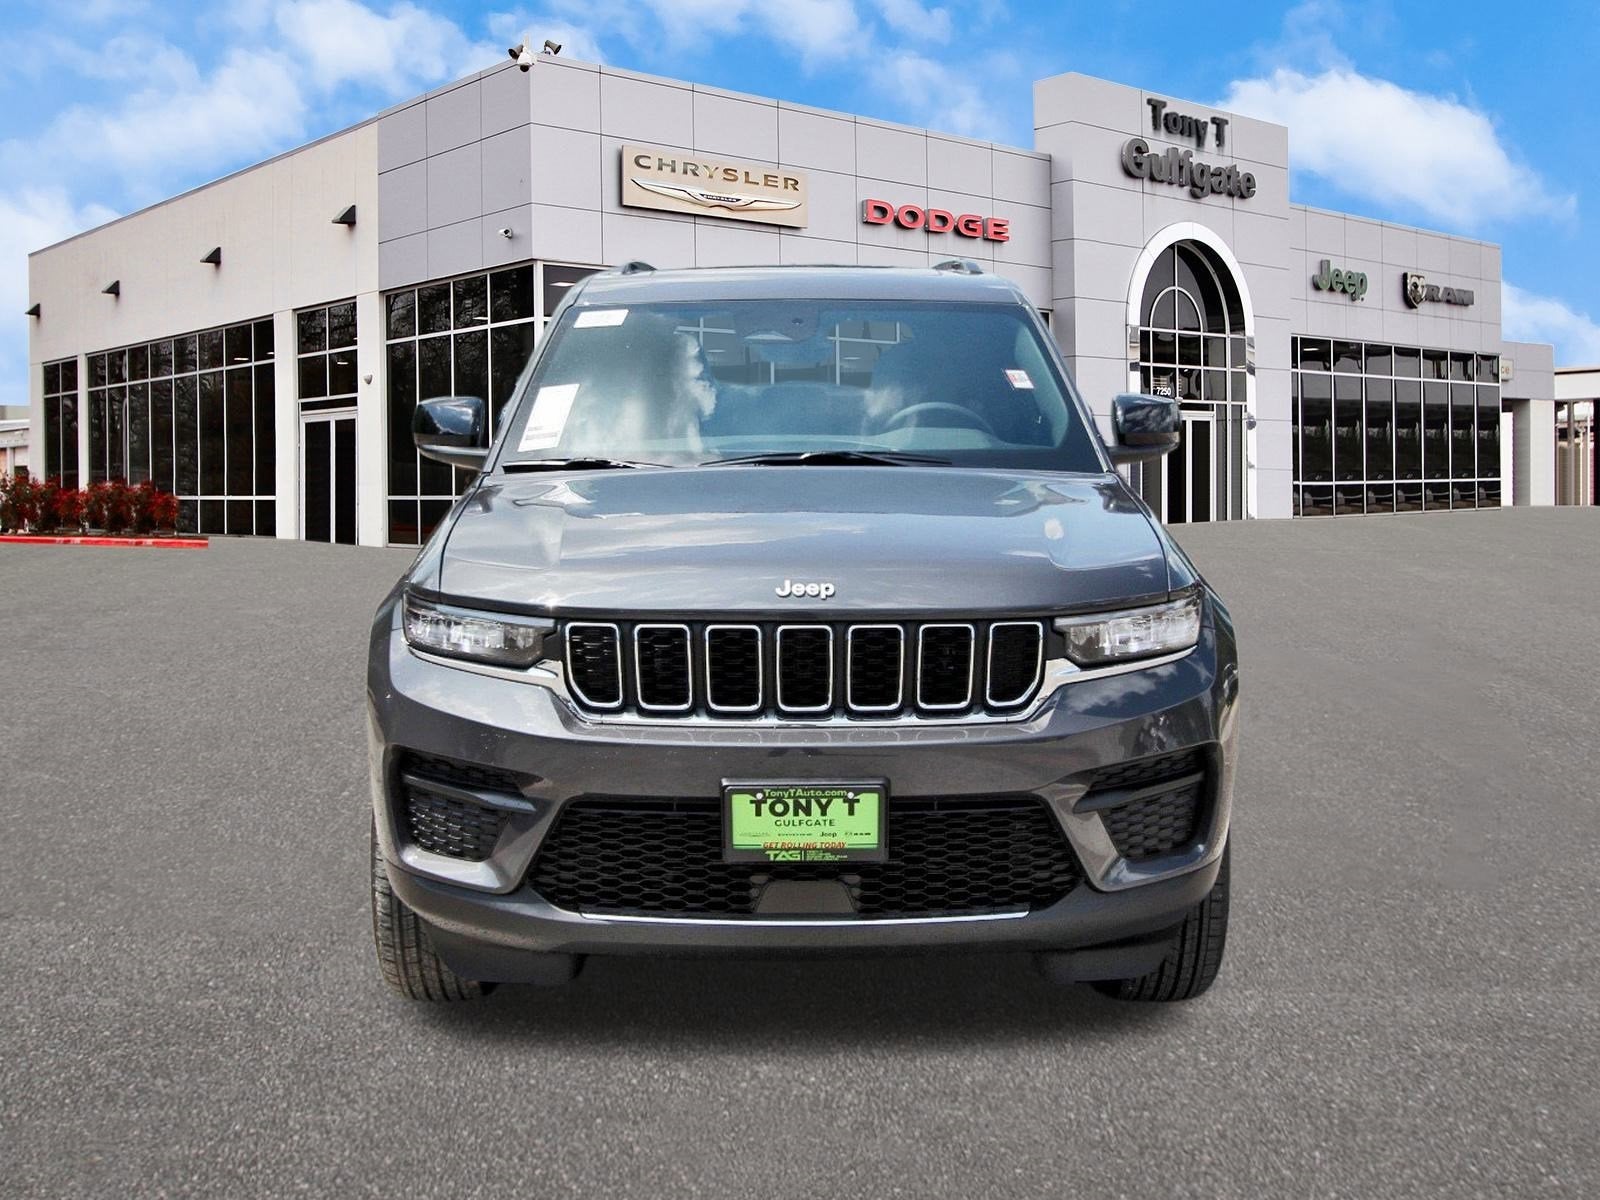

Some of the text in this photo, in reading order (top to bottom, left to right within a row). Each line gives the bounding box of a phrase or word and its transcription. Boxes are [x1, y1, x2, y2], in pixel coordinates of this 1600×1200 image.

[1147, 98, 1229, 149] Tony T
[634, 154, 800, 192] CHRYSLER
[1121, 137, 1257, 200] Gulfgate
[863, 198, 1010, 243] DODGE
[1312, 259, 1368, 302] Jeep
[1425, 283, 1475, 307] RAM
[1156, 387, 1171, 396] 7250
[775, 579, 836, 600] Jeep
[763, 788, 848, 798] TonyTAuto.com
[750, 798, 861, 817] TONY T
[774, 819, 836, 827] GULFGATE
[763, 841, 847, 849] GET ROLLING TODAY
[765, 850, 801, 861] TAG
